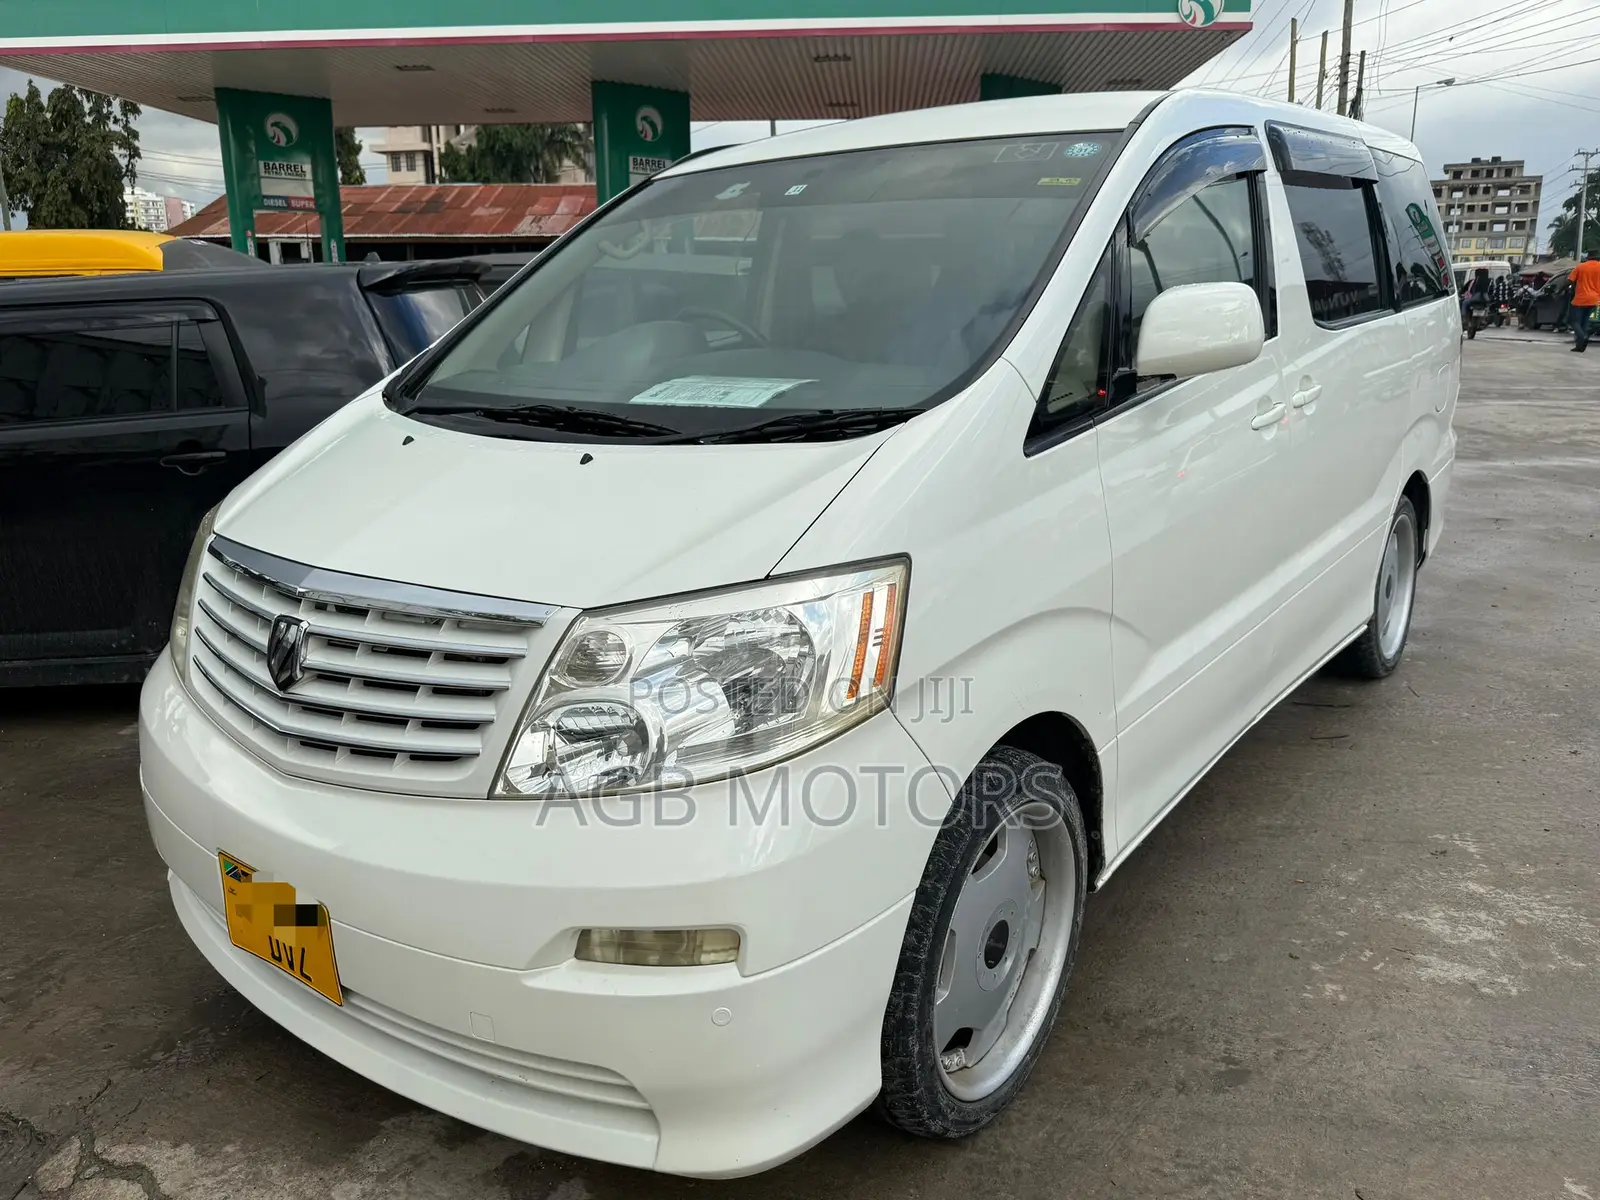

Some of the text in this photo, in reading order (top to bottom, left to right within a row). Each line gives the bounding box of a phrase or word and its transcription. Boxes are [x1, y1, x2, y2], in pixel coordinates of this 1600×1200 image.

[263, 162, 307, 173] BARREL
[263, 198, 316, 209] DIESEL SUPER
